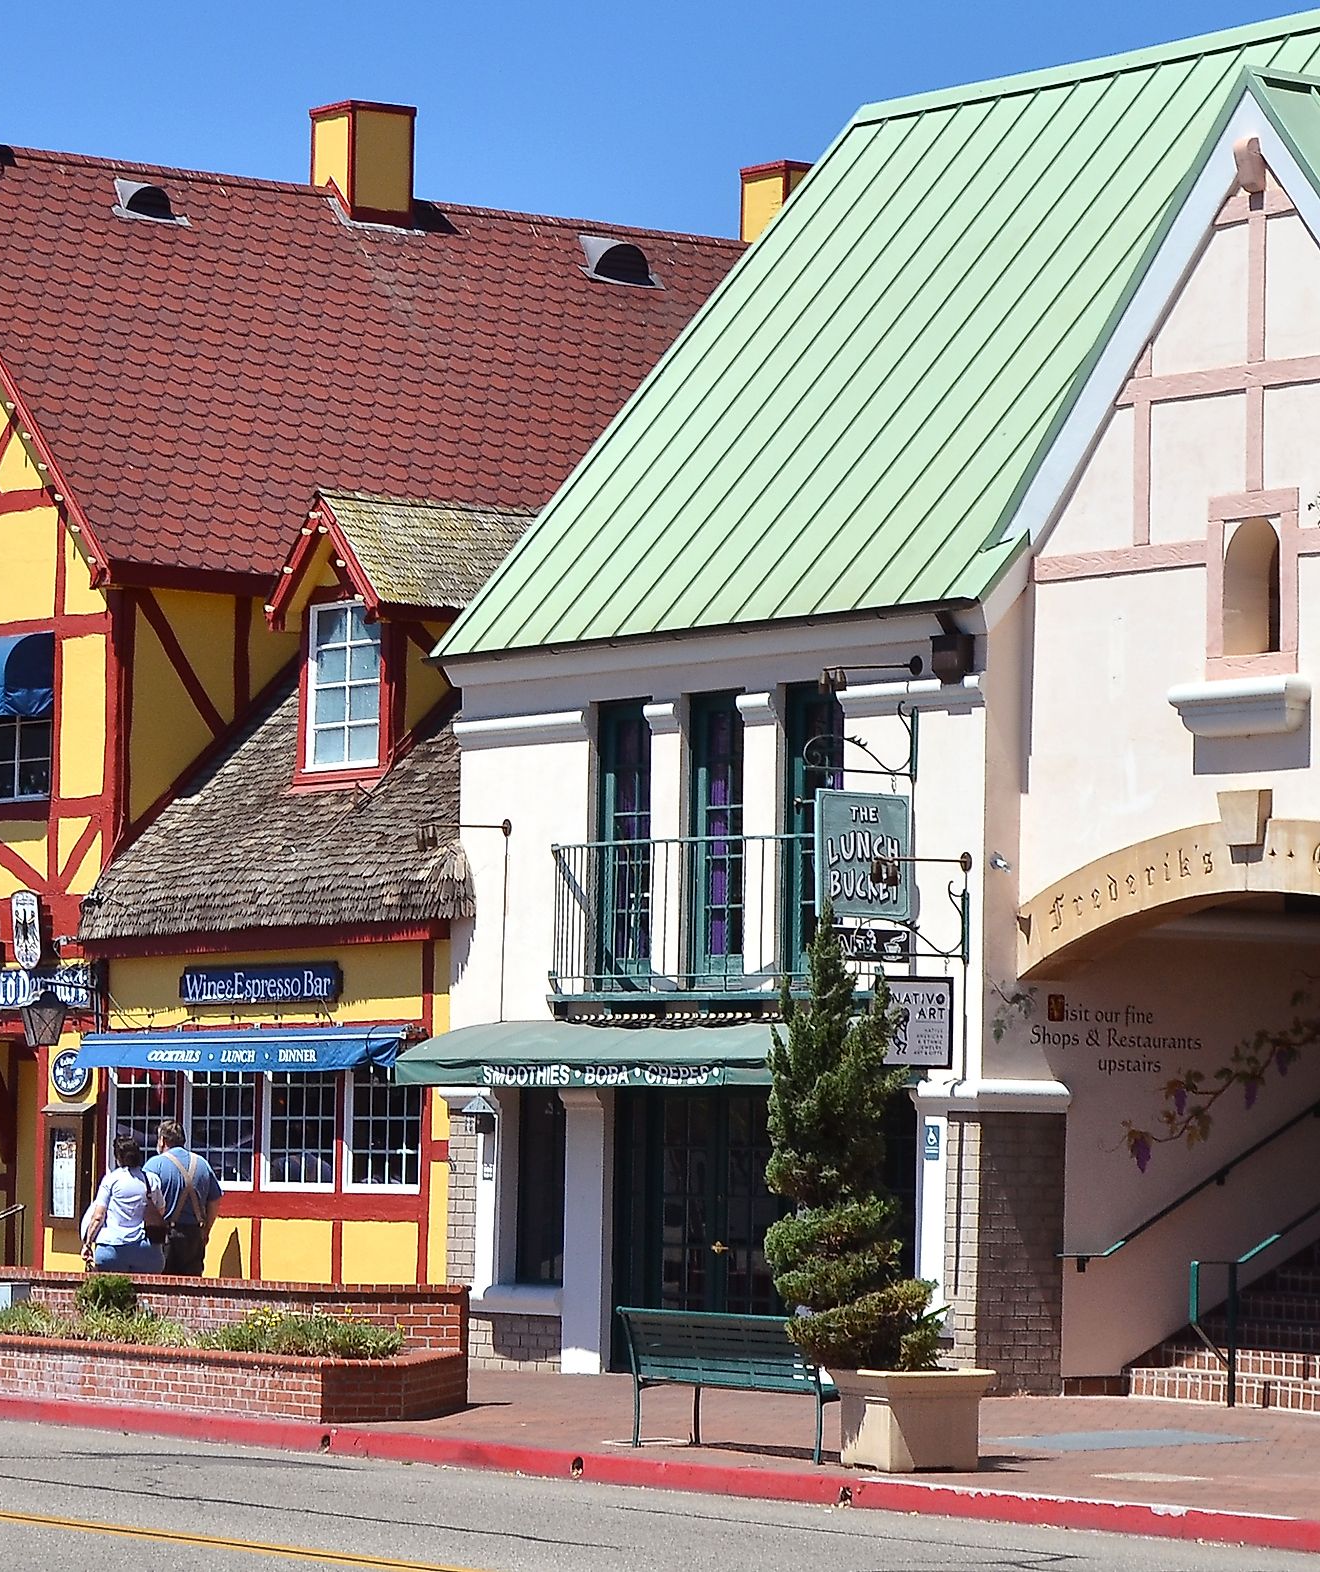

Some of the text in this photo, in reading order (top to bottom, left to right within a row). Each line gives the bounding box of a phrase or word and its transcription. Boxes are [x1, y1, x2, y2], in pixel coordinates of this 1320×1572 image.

[850, 805, 879, 823] THE
[827, 830, 901, 867] LUNCH
[1048, 844, 1216, 934] Frederik's
[302, 970, 331, 997] Bar
[891, 991, 946, 1005] NATIVO
[917, 1007, 946, 1020] ART
[1095, 1009, 1121, 1022] our
[1125, 1005, 1154, 1027] fine
[1029, 1024, 1203, 1050] Shops & Restaurants
[146, 1049, 317, 1063] COCKTAILS LUNCH DINNER
[1098, 1055, 1162, 1075] upstairs
[482, 1064, 709, 1085] SMOOTHIES BOBA CREPES
